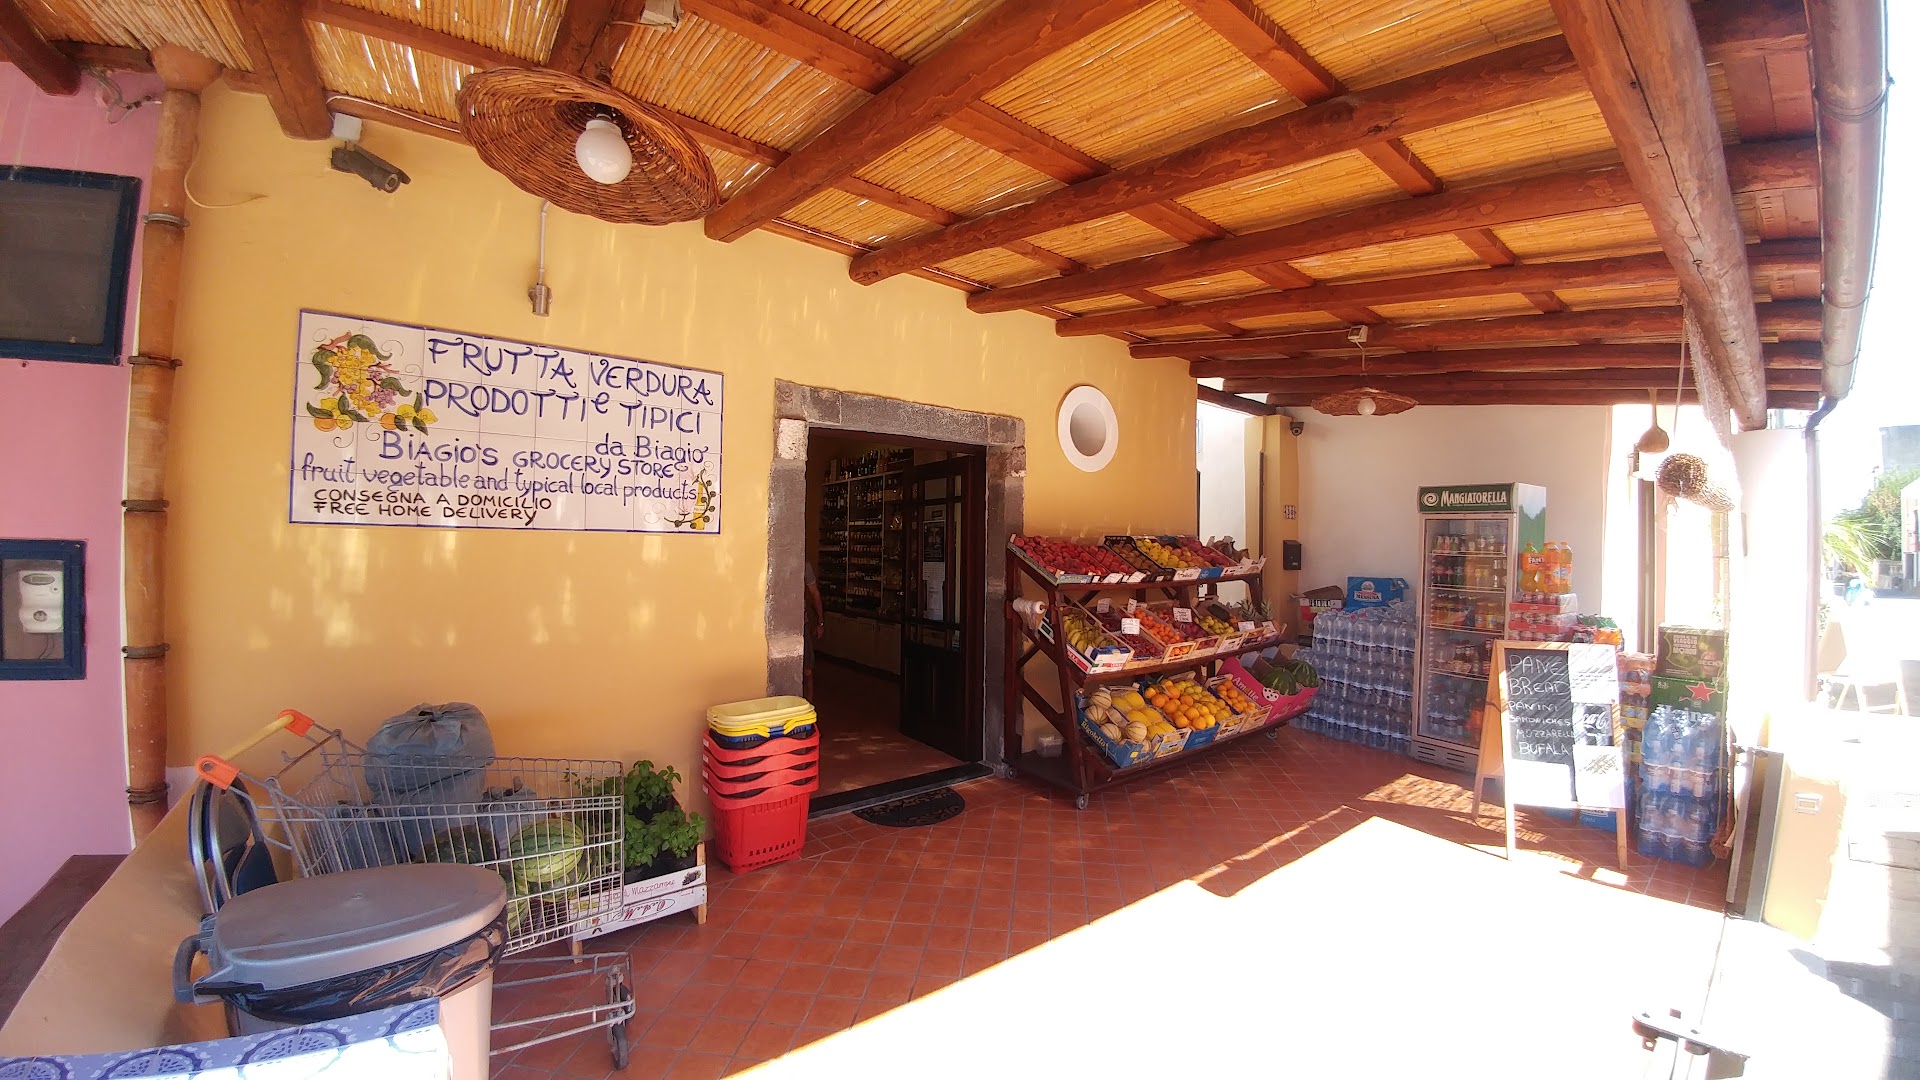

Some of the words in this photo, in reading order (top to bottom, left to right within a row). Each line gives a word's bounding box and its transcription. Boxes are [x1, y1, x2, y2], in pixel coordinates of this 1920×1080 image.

[428, 337, 577, 388] FRUTTA
[590, 359, 714, 406] VERDURA
[424, 379, 586, 422] PRODOTTI
[590, 392, 610, 414] e
[619, 400, 701, 435] TIPICI
[512, 451, 612, 479] GROCERY
[618, 459, 675, 478] STORE
[595, 433, 627, 457] da
[634, 435, 709, 472] Biagio
[302, 452, 356, 484] fruit
[362, 461, 471, 492] vegetable
[473, 467, 509, 491] and
[515, 468, 574, 504] typical
[580, 472, 619, 497] local
[623, 478, 698, 506] products
[314, 488, 426, 504] CONSEGNA
[436, 493, 451, 505] A
[458, 494, 552, 510] DOMICILIO
[1441, 490, 1507, 507] MANGIATORELLA
[313, 501, 371, 516] FREE
[379, 504, 432, 517] HOME
[443, 506, 538, 526] DELIVERY
[1509, 654, 1564, 676] PANE
[1509, 676, 1571, 696] BREAD
[1507, 700, 1559, 712] PANINI
[1081, 721, 1107, 747] Rigoletto
[1519, 741, 1571, 757] BUFALA
